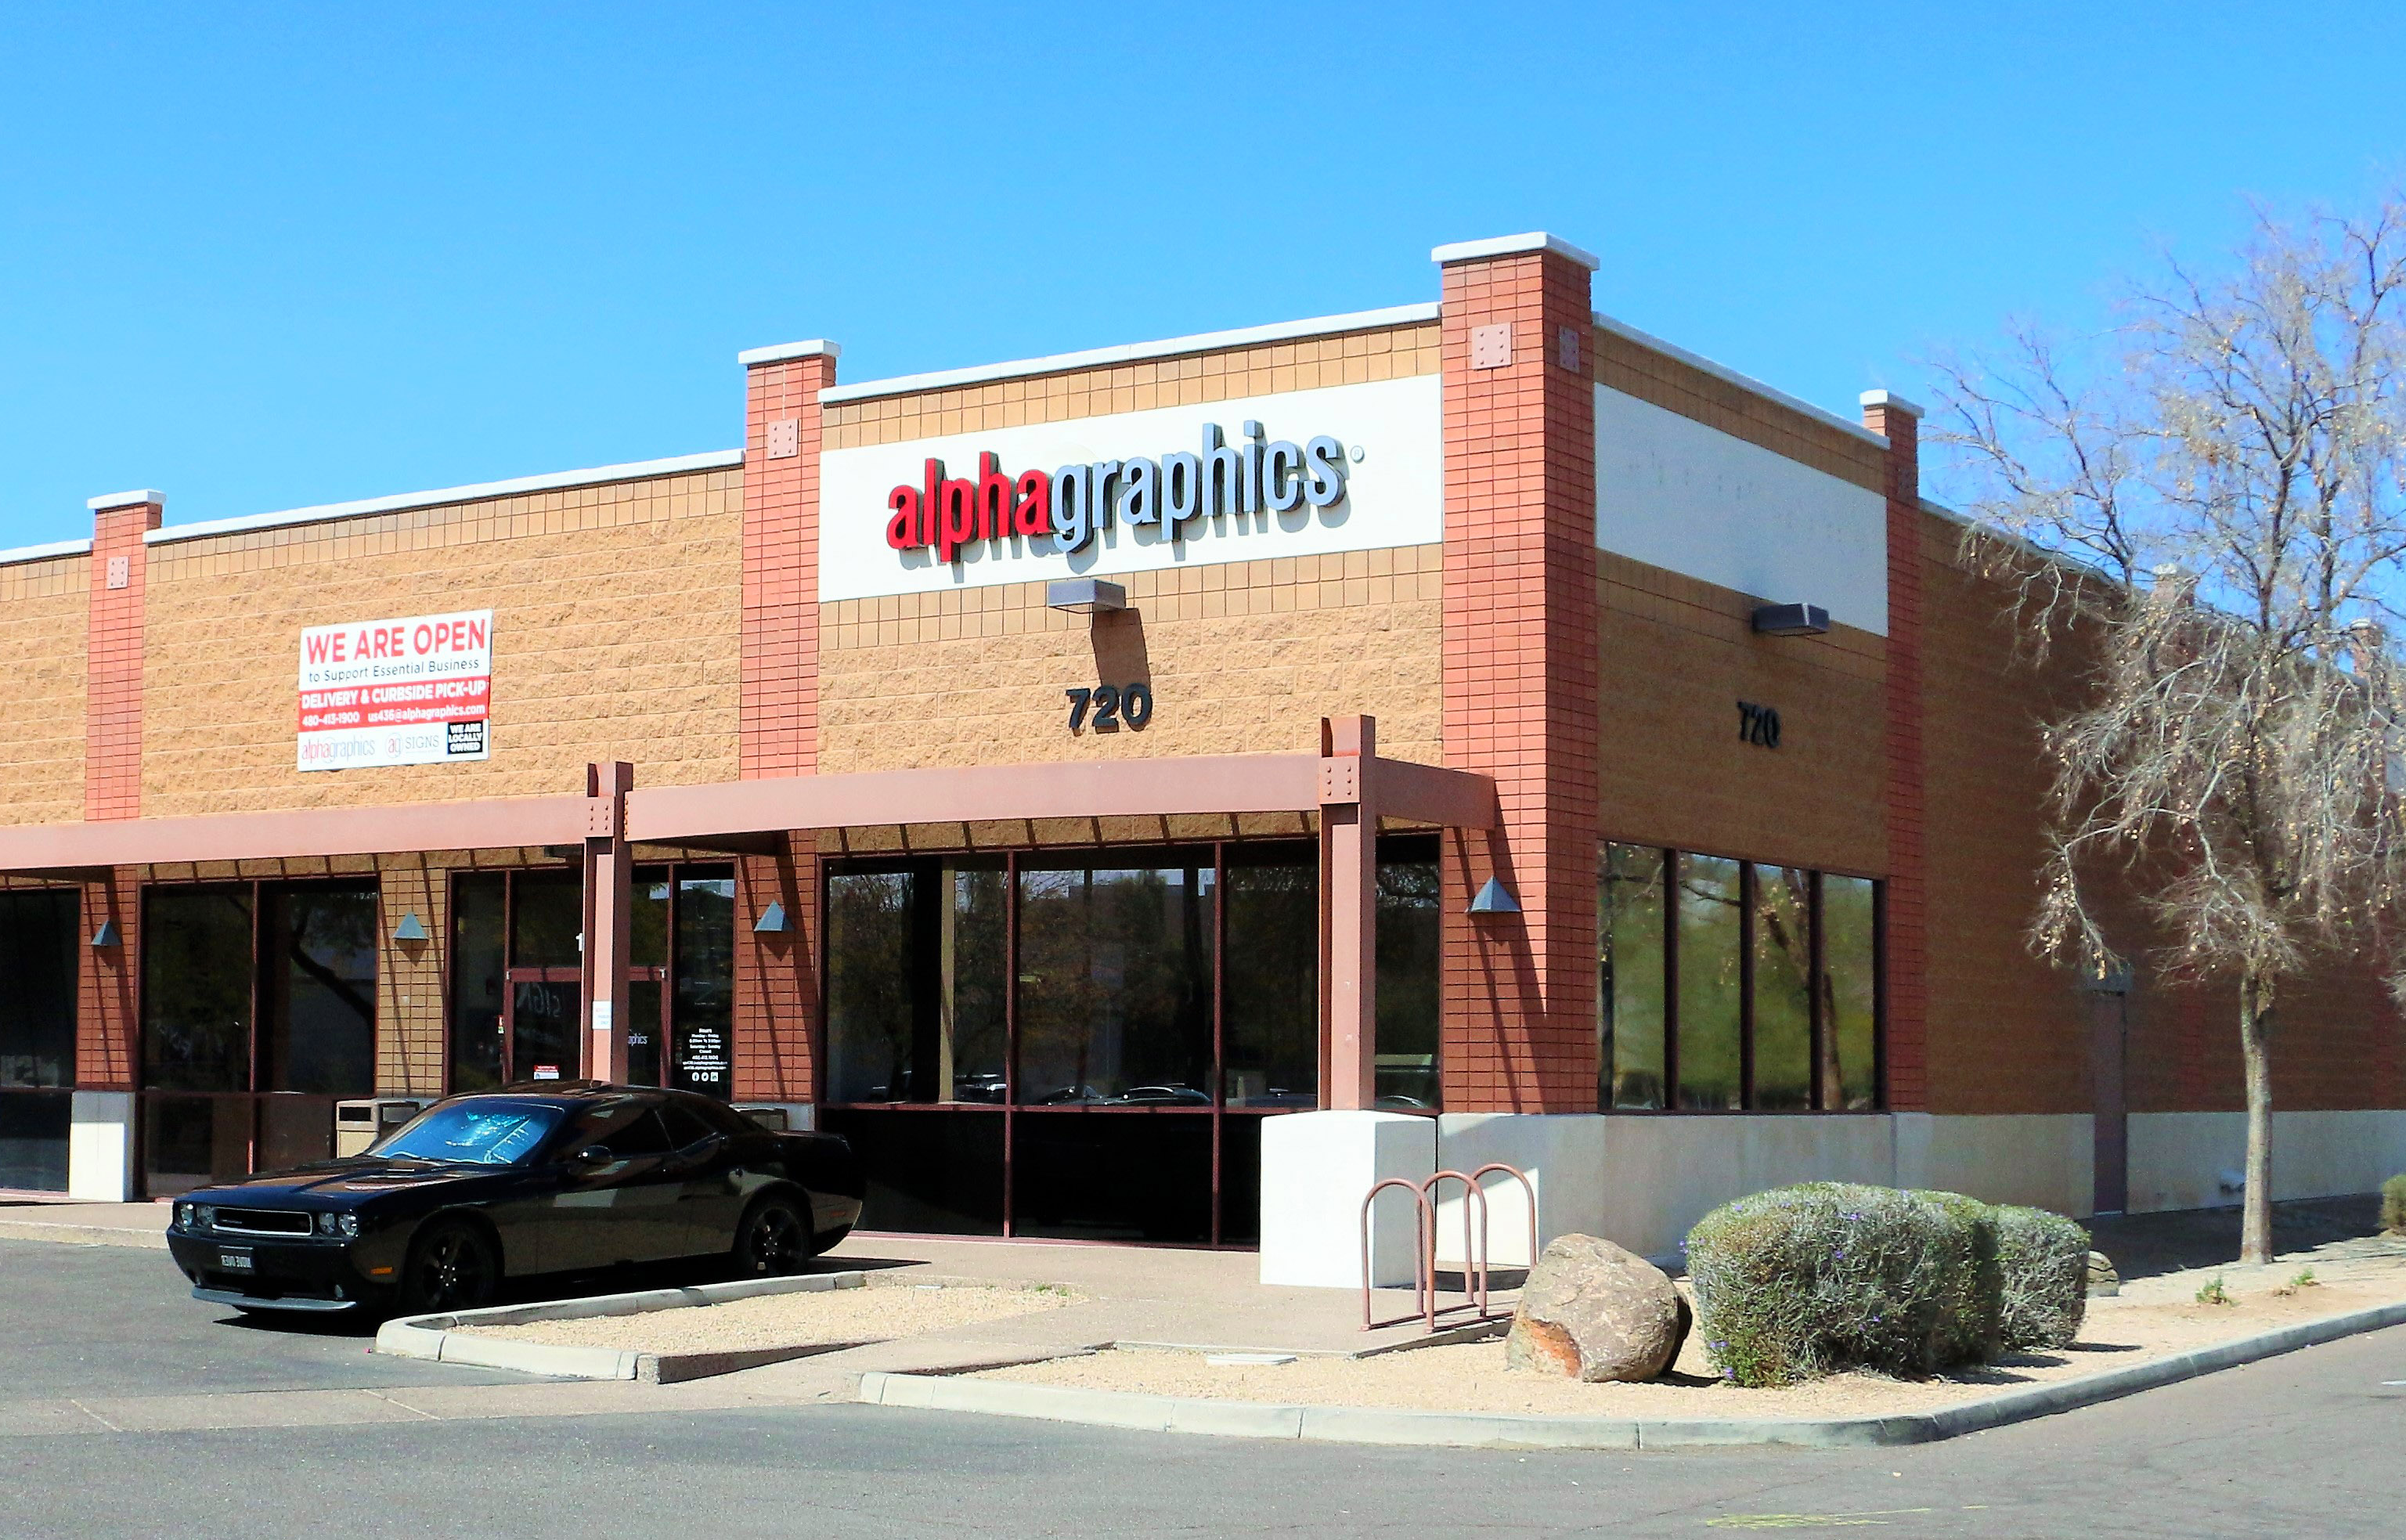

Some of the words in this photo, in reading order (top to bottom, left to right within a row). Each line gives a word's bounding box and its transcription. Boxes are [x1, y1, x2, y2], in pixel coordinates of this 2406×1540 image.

[886, 420, 1345, 563] alphagraphics
[306, 633, 346, 665] WE
[354, 627, 405, 660] ARE
[413, 619, 485, 655] OPEN
[309, 673, 320, 683] to
[324, 668, 368, 683] Support
[373, 661, 424, 677] Essential
[430, 658, 479, 673] Business
[301, 690, 359, 709] DELIVERY
[361, 689, 370, 705] &
[372, 683, 434, 704] CURBSIDE
[435, 680, 486, 698] PICK-UP
[1066, 683, 1152, 734] 720
[302, 711, 360, 727] 480-413-1900
[449, 724, 464, 734] WE
[465, 723, 482, 733] ARE
[1737, 701, 1781, 748] 720
[301, 735, 375, 763] alphagraphics
[406, 735, 438, 749] SIGNS
[448, 732, 482, 743] LOCALLY
[449, 742, 481, 752] OWNED
